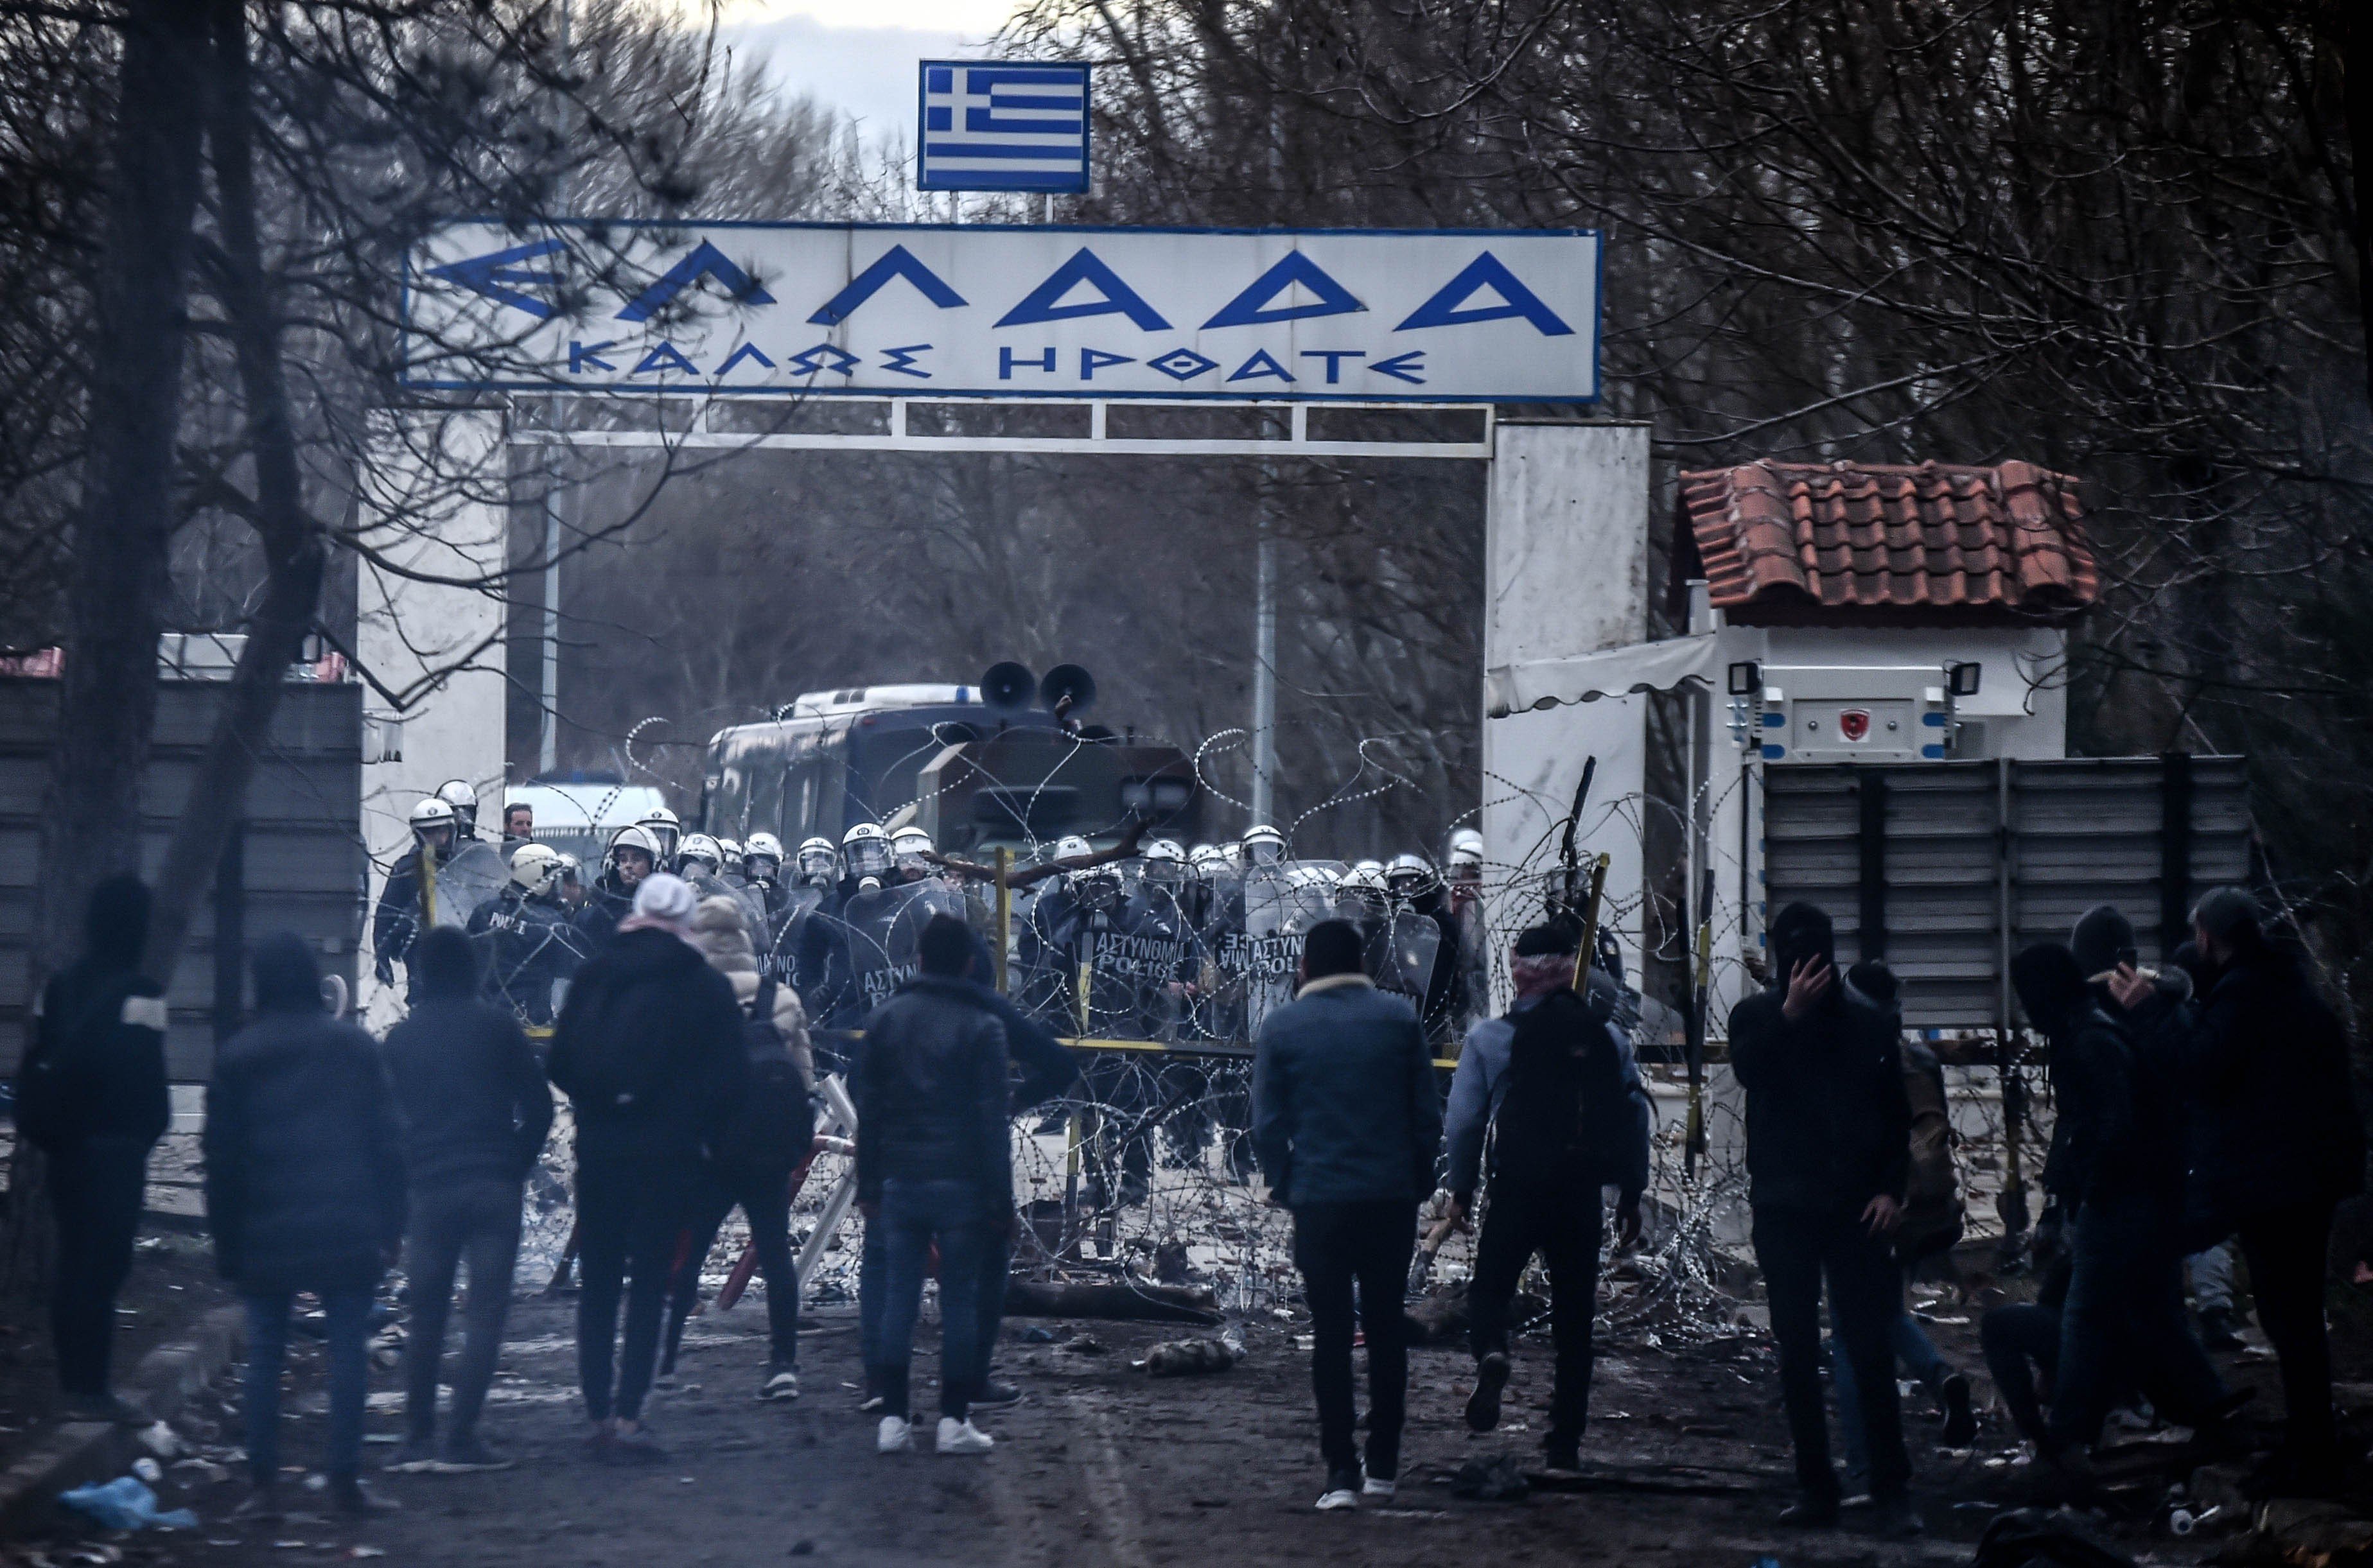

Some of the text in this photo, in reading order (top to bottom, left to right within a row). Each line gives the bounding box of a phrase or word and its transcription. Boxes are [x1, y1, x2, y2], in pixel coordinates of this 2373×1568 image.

[425, 238, 1576, 336] ΕΛΛΑΔΑ
[569, 339, 1428, 385] ΚΑΛΩΣ ΗΡΘΑΤΕ
